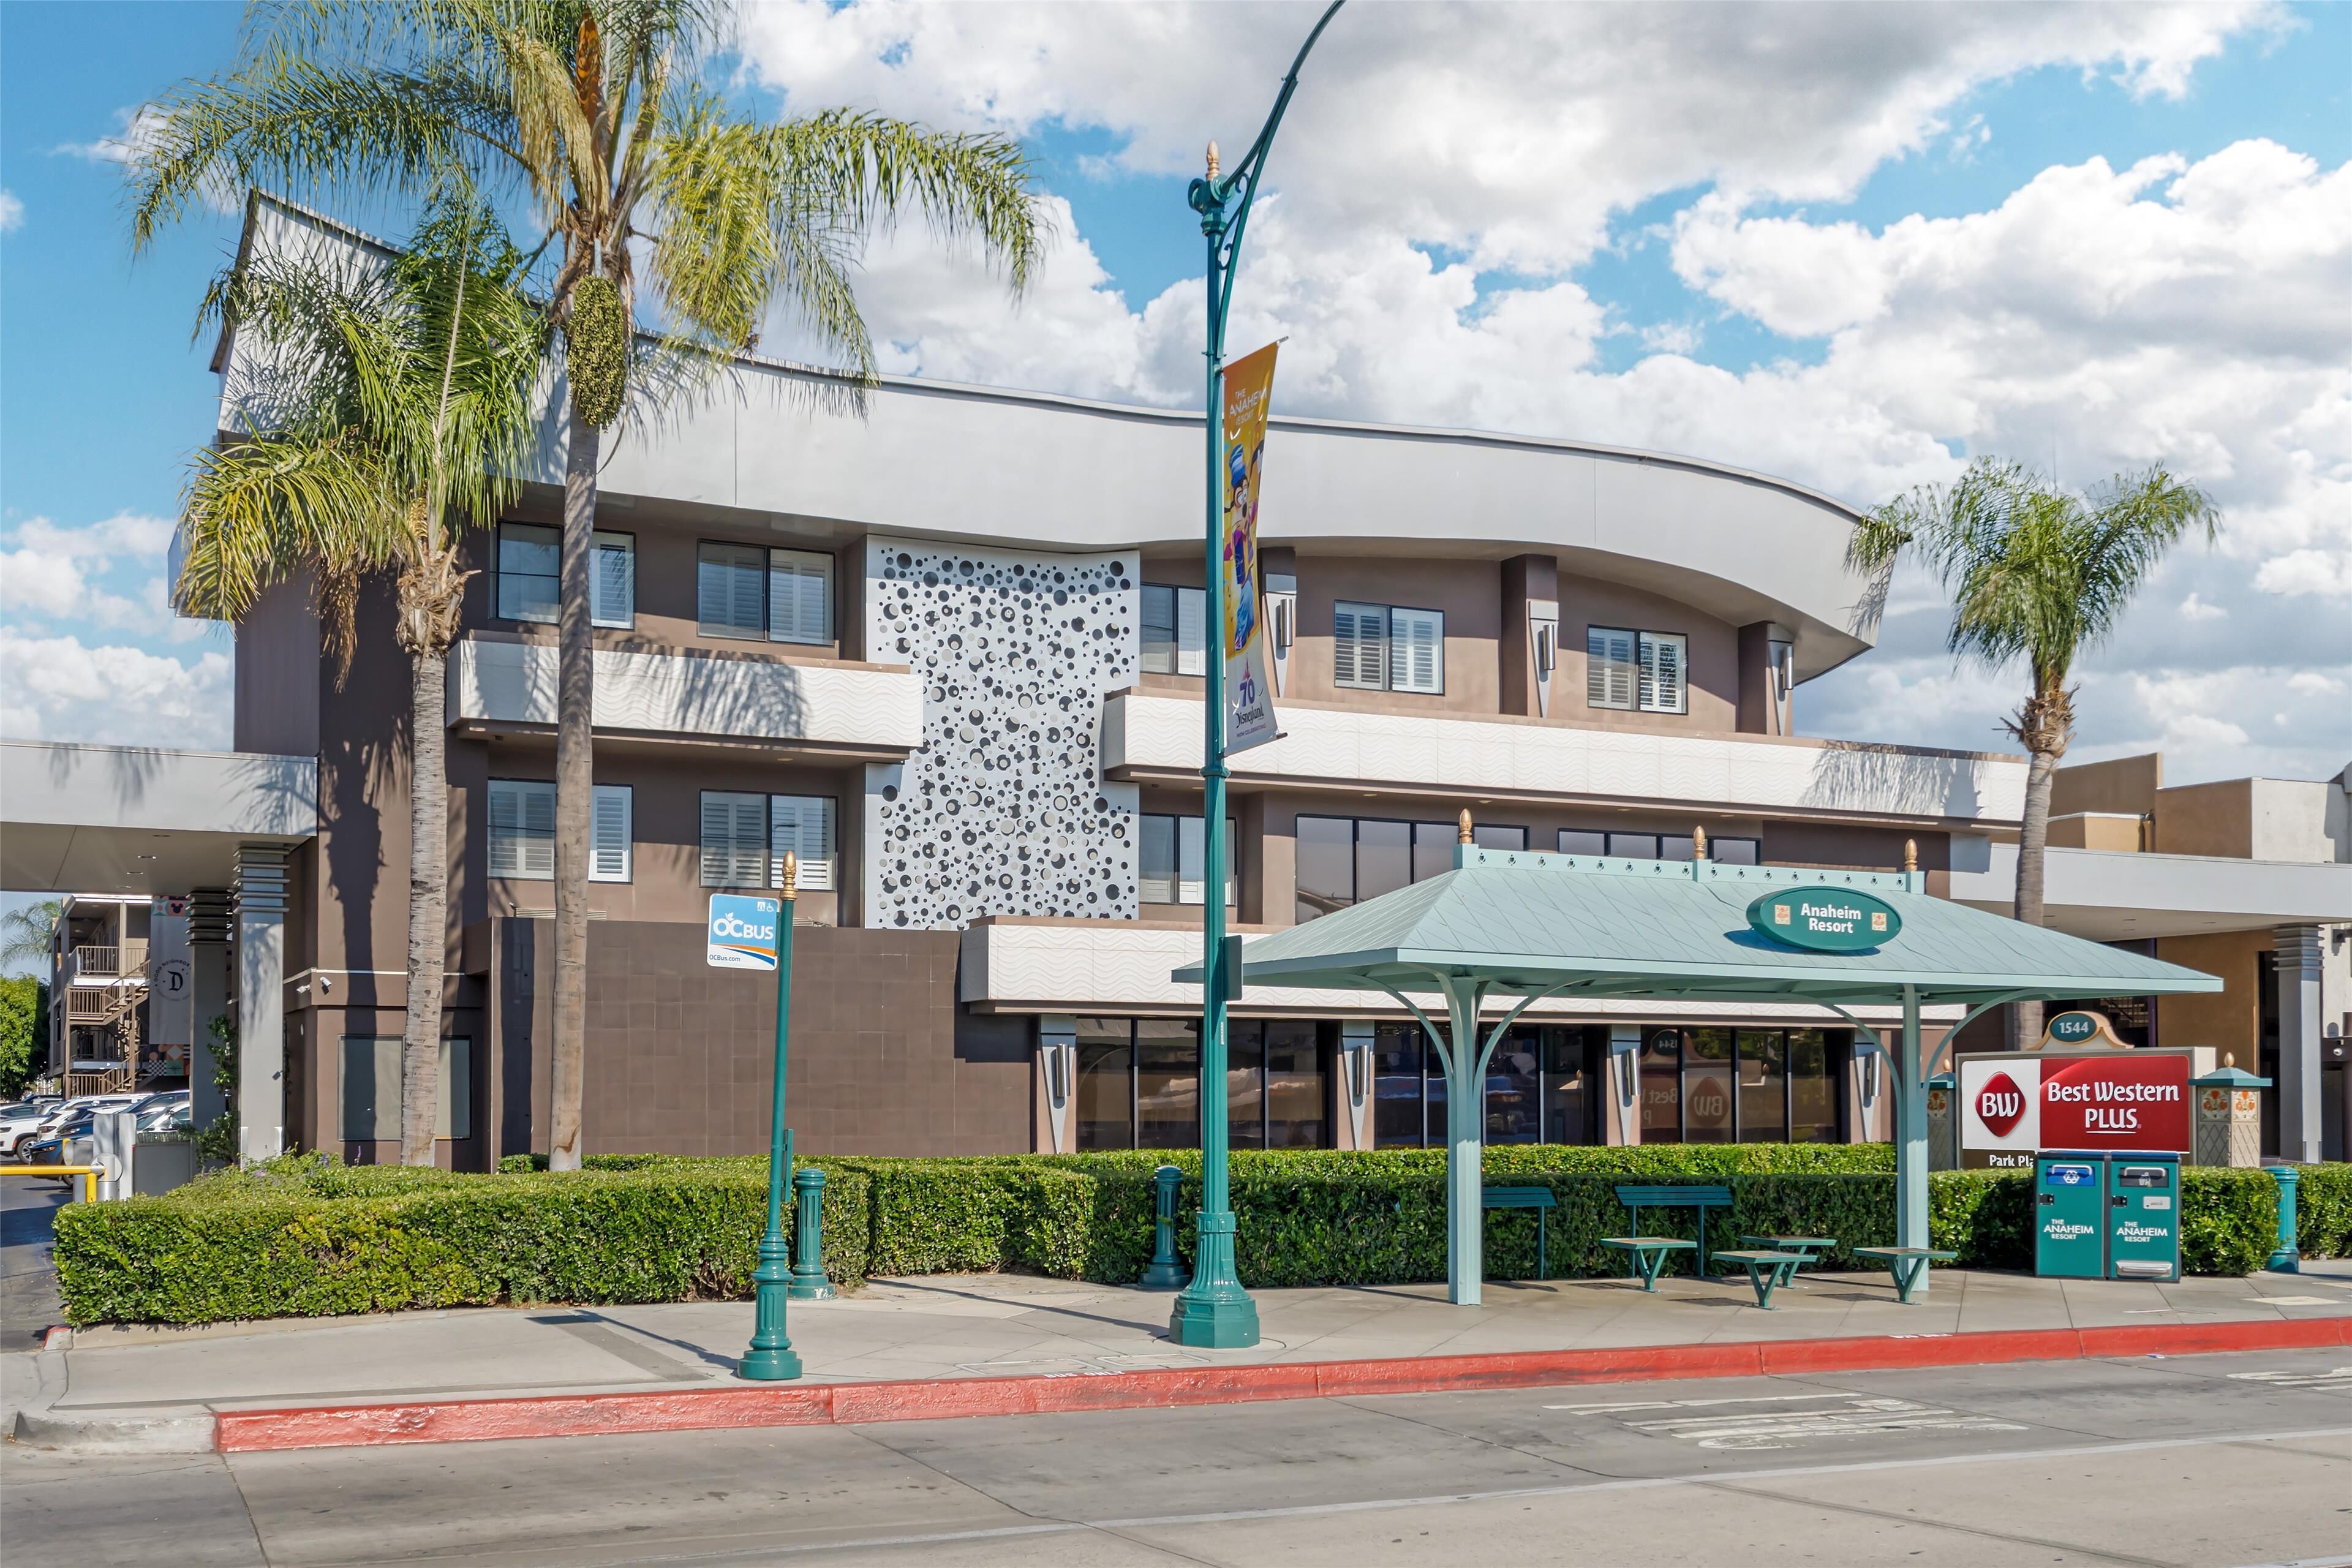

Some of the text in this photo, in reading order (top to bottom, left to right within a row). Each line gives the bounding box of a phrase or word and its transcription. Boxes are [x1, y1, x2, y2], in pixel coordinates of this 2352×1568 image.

[1235, 388, 1246, 399] THE
[1240, 679, 1255, 707] 70
[1801, 903, 1861, 920] Anaheim
[1809, 918, 1853, 933] Resort
[167, 970, 184, 992] D
[2059, 1022, 2089, 1034] 1544
[2048, 1082, 2180, 1102] Best Western
[1982, 1093, 2019, 1117] BW
[2085, 1109, 2138, 1129] PLUS
[1989, 1155, 2015, 1166] Park
[2043, 1224, 2094, 1234] ANAHEIM
[2116, 1227, 2168, 1237] ANAHEIM
